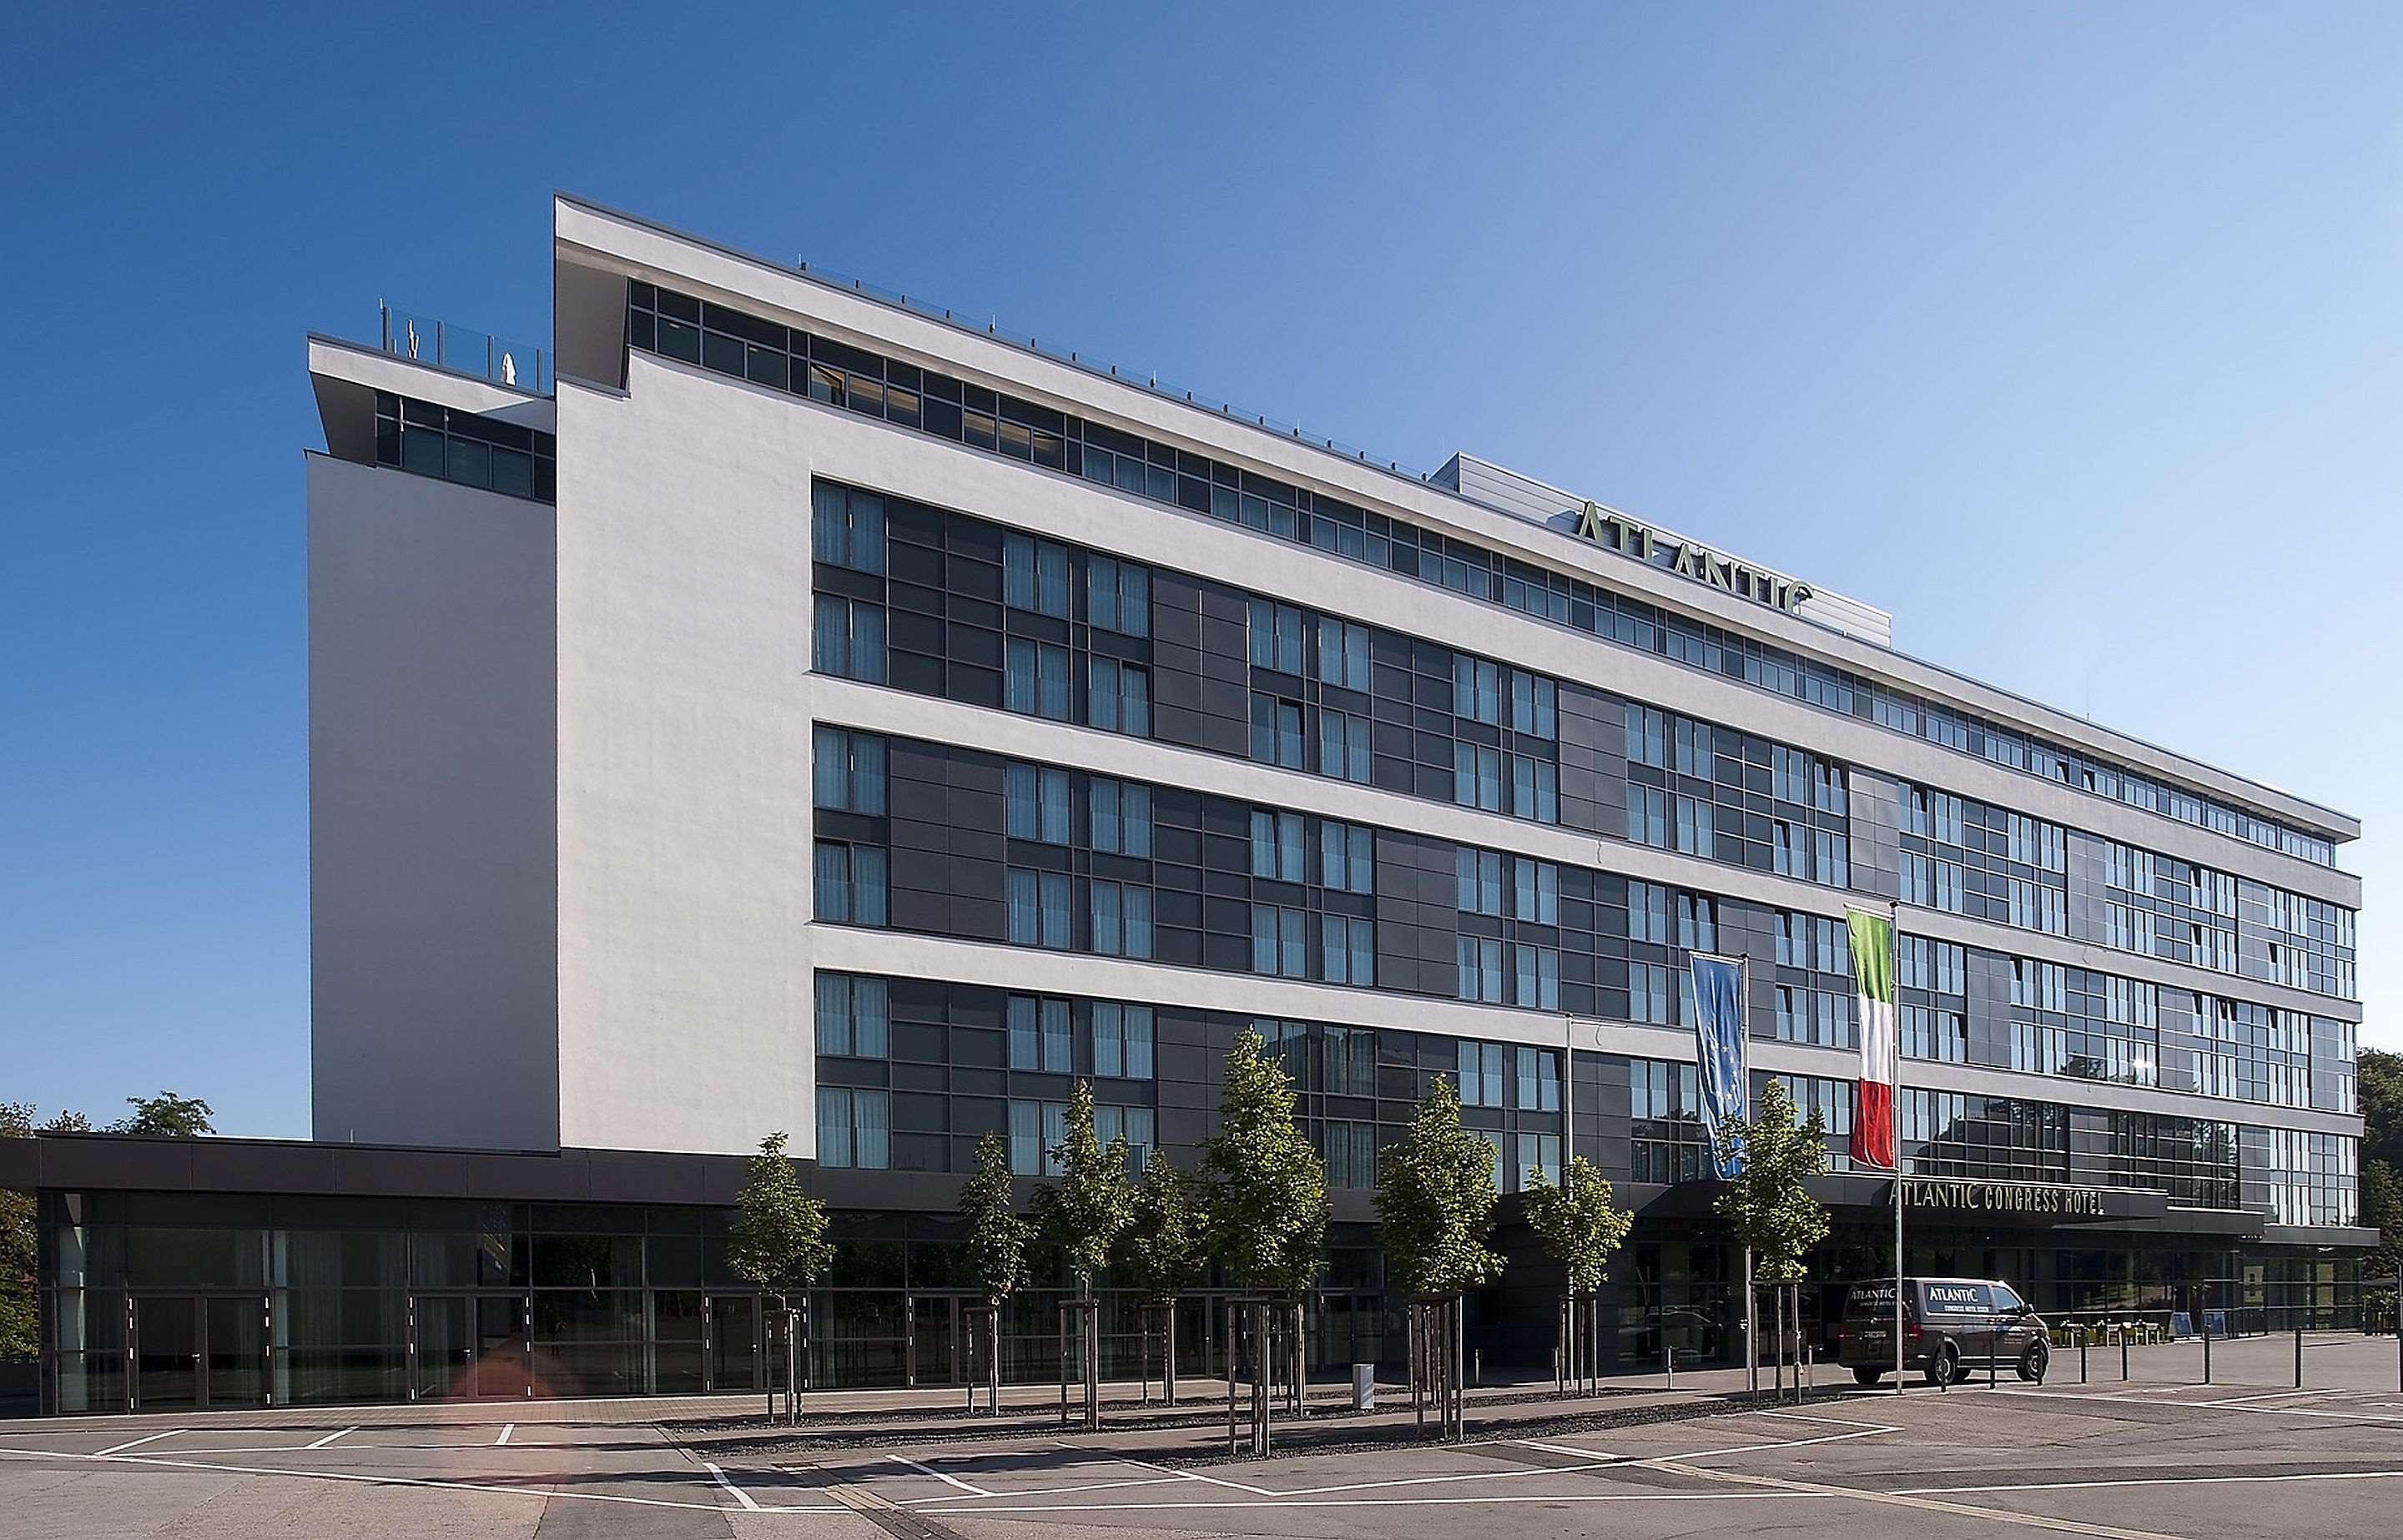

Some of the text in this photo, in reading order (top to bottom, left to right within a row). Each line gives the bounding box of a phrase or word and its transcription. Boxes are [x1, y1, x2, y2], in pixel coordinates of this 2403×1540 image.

[1578, 501, 1814, 615] ATLANTIC
[1985, 1185, 2058, 1212] CONGRESS
[2064, 1189, 2105, 1215] HOTEL
[1850, 1288, 1897, 1300] ATLANTIC
[1929, 1286, 1978, 1302] ATLANTIC
